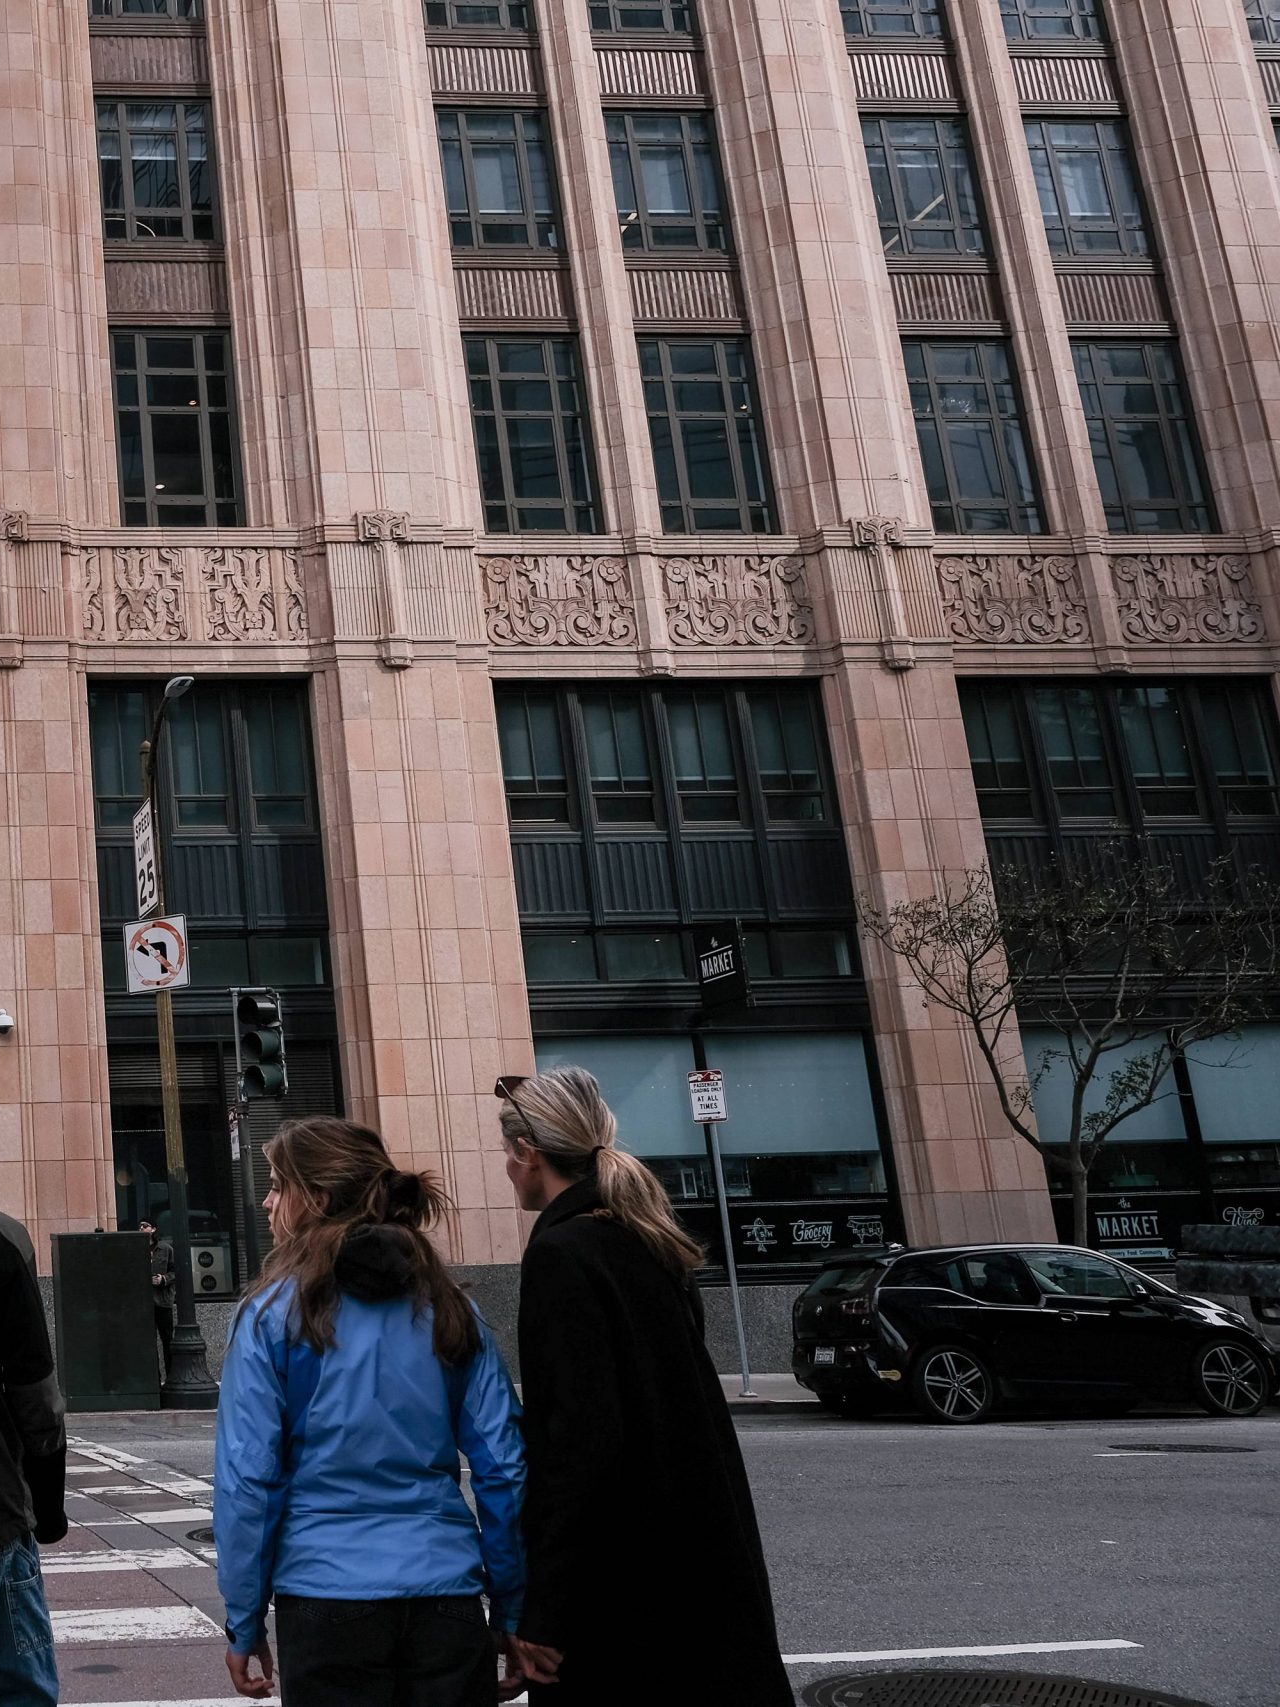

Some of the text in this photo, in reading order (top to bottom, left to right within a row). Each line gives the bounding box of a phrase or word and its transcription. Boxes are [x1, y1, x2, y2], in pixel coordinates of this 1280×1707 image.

[135, 812, 151, 840] SPEED
[137, 836, 151, 861] LIMIT
[138, 859, 155, 908] 25
[700, 949, 734, 979] MARKET
[1118, 1198, 1131, 1209] the
[1096, 1215, 1159, 1237] MARKET
